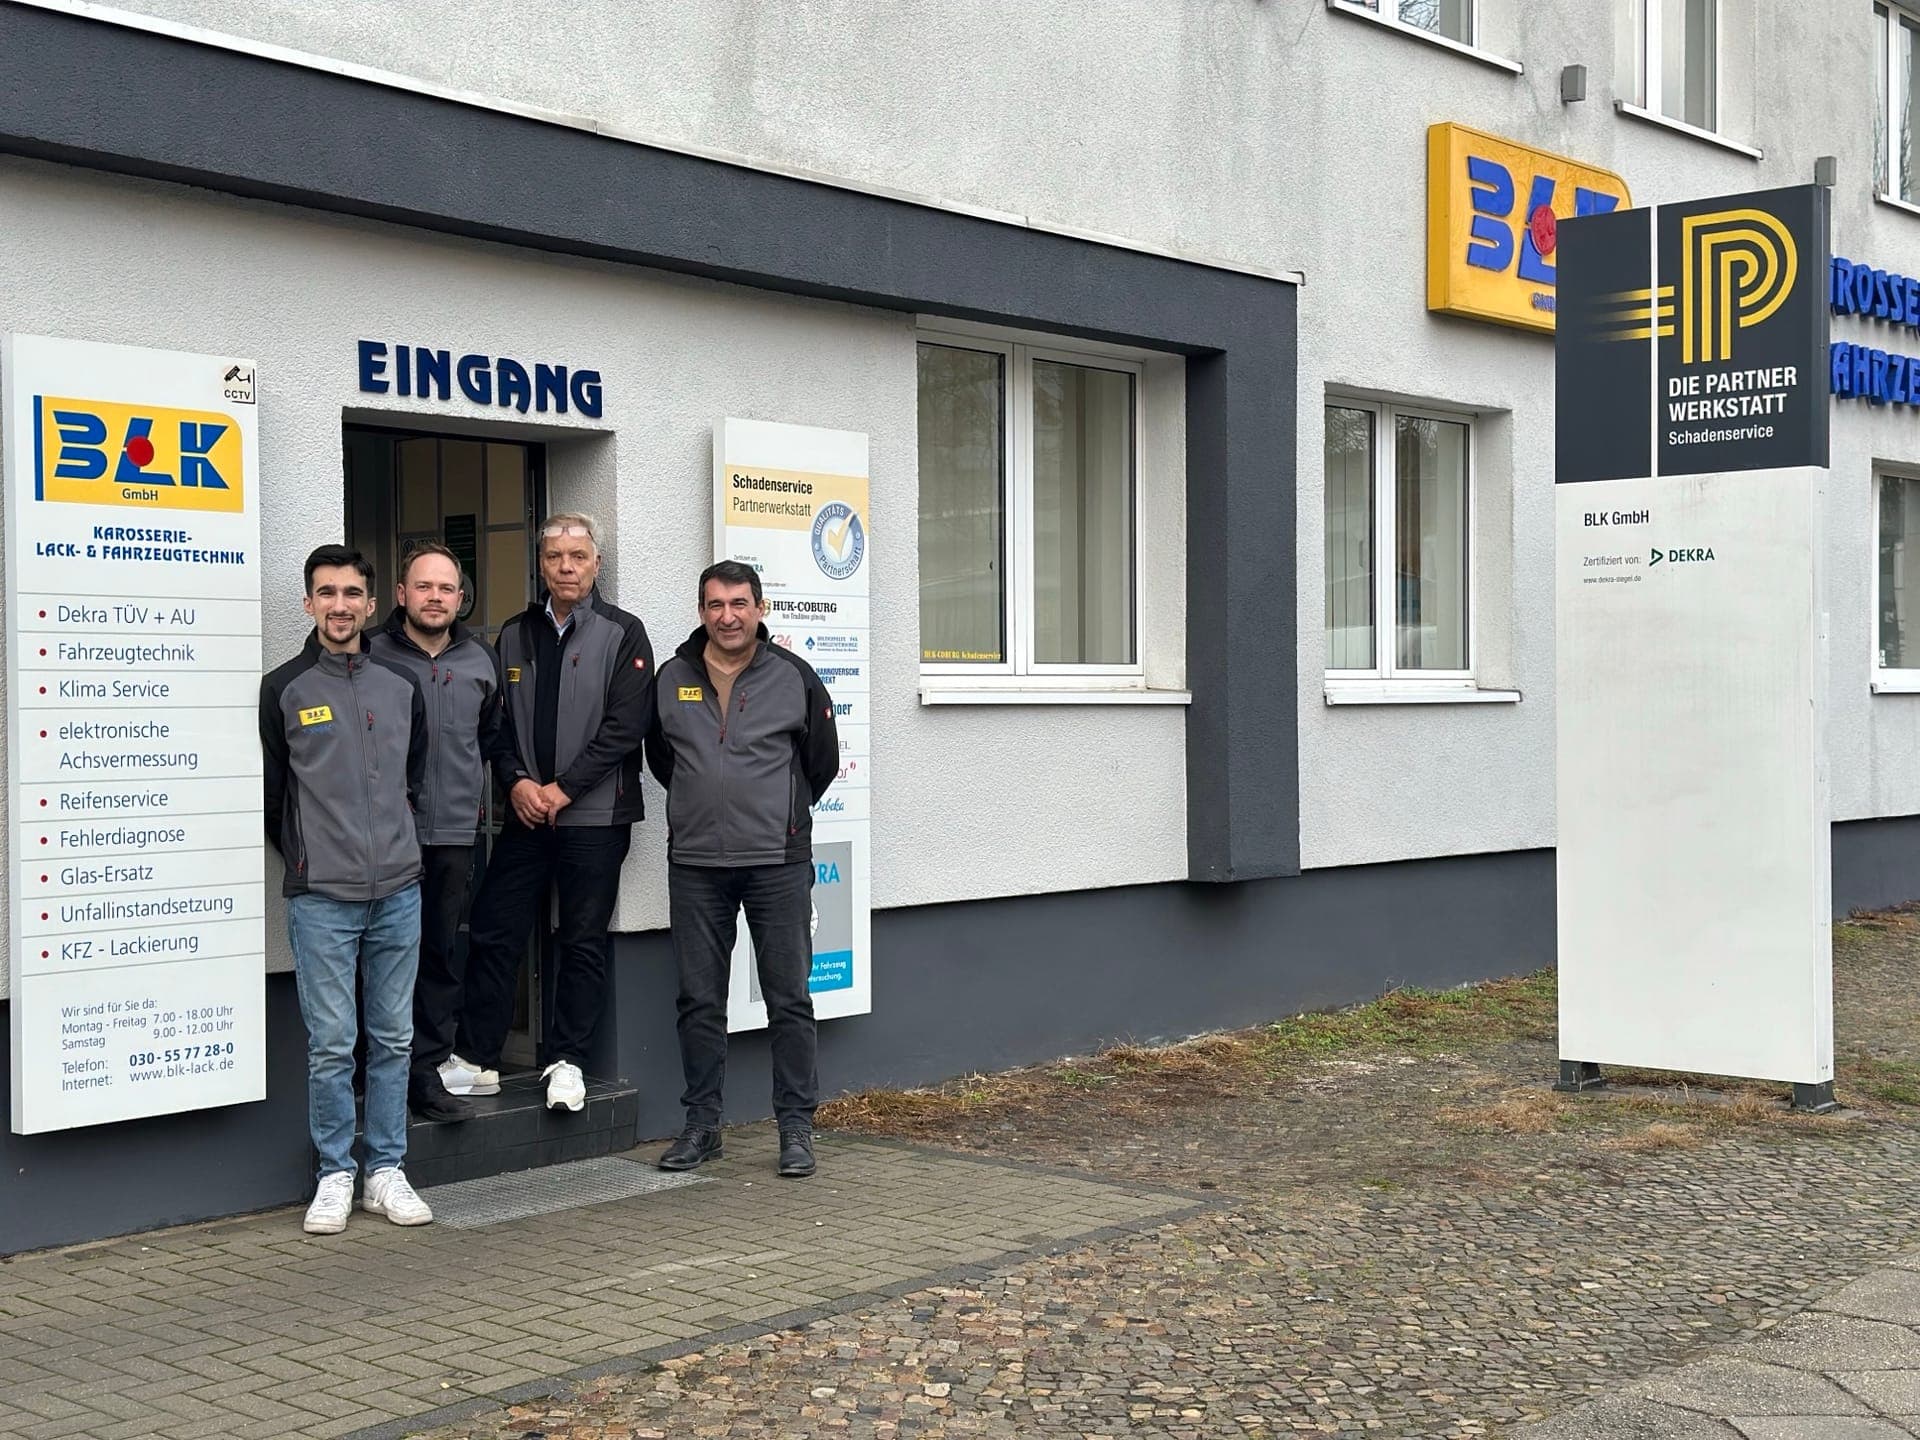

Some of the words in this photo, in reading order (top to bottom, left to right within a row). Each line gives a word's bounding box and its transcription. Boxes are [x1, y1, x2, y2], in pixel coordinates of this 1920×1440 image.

[1467, 155, 1620, 285] BL
[358, 340, 602, 418] EINGANG
[1669, 375, 1700, 397] DIE
[1706, 366, 1797, 393] PARTNER
[1831, 341, 1920, 407] AHRZE
[224, 389, 251, 401] CCTV
[1669, 393, 1787, 422] WERKSTATT
[1669, 424, 1774, 445] Schadenservice
[53, 410, 230, 489] BLK
[122, 488, 159, 501] GmbH
[733, 473, 813, 495] Schadenservice
[733, 496, 811, 517] Partnerwerkstatt
[1584, 512, 1608, 527] BLK
[1612, 510, 1649, 525] GmbH
[93, 526, 193, 544] KAROSSERIE-
[36, 542, 81, 558] LACK-
[87, 544, 97, 559] &
[102, 545, 245, 565] FAHRZEUGTECHNIK
[820, 547, 861, 577] Partnerschaft
[1583, 556, 1622, 567] Zertifiziert
[1625, 556, 1641, 565] von:
[1669, 548, 1715, 562] DEKRA
[58, 605, 108, 624] Dekra
[113, 604, 148, 624] TÜV
[154, 612, 165, 623] +
[170, 608, 195, 625] AU
[773, 600, 837, 613] HUK-COBURG
[58, 643, 195, 664] Fahrzeugtechnik
[59, 680, 107, 698] Klima
[112, 680, 170, 698] Service
[59, 721, 170, 740] elektronische
[59, 751, 199, 770] Achsvermessung
[60, 790, 169, 810] Reifenservice
[60, 827, 186, 848] Fehlerdiagnose
[60, 865, 154, 885] Glas-Ersatz
[60, 896, 234, 923] Unfallinstandsetzung
[61, 941, 93, 960] KFZ
[111, 935, 199, 956] Lackierung
[61, 1006, 80, 1018] Wir
[83, 1002, 104, 1016] sind
[107, 1001, 121, 1013] für
[125, 999, 140, 1011] Sie
[142, 998, 158, 1010] da:
[62, 1020, 103, 1035] Montag
[112, 1015, 147, 1029] Freitag
[153, 1011, 176, 1025] 7.00
[186, 1007, 213, 1021] 18.00
[216, 1005, 234, 1017] Uhr
[62, 1035, 106, 1050] Samstag
[153, 1026, 176, 1039] 9.00
[186, 1021, 213, 1035] 12.00
[216, 1019, 234, 1031] Uhr
[62, 1060, 108, 1075] Telefon:
[62, 1075, 113, 1091] Internet:
[129, 1057, 234, 1082] www.blk-lack.de
